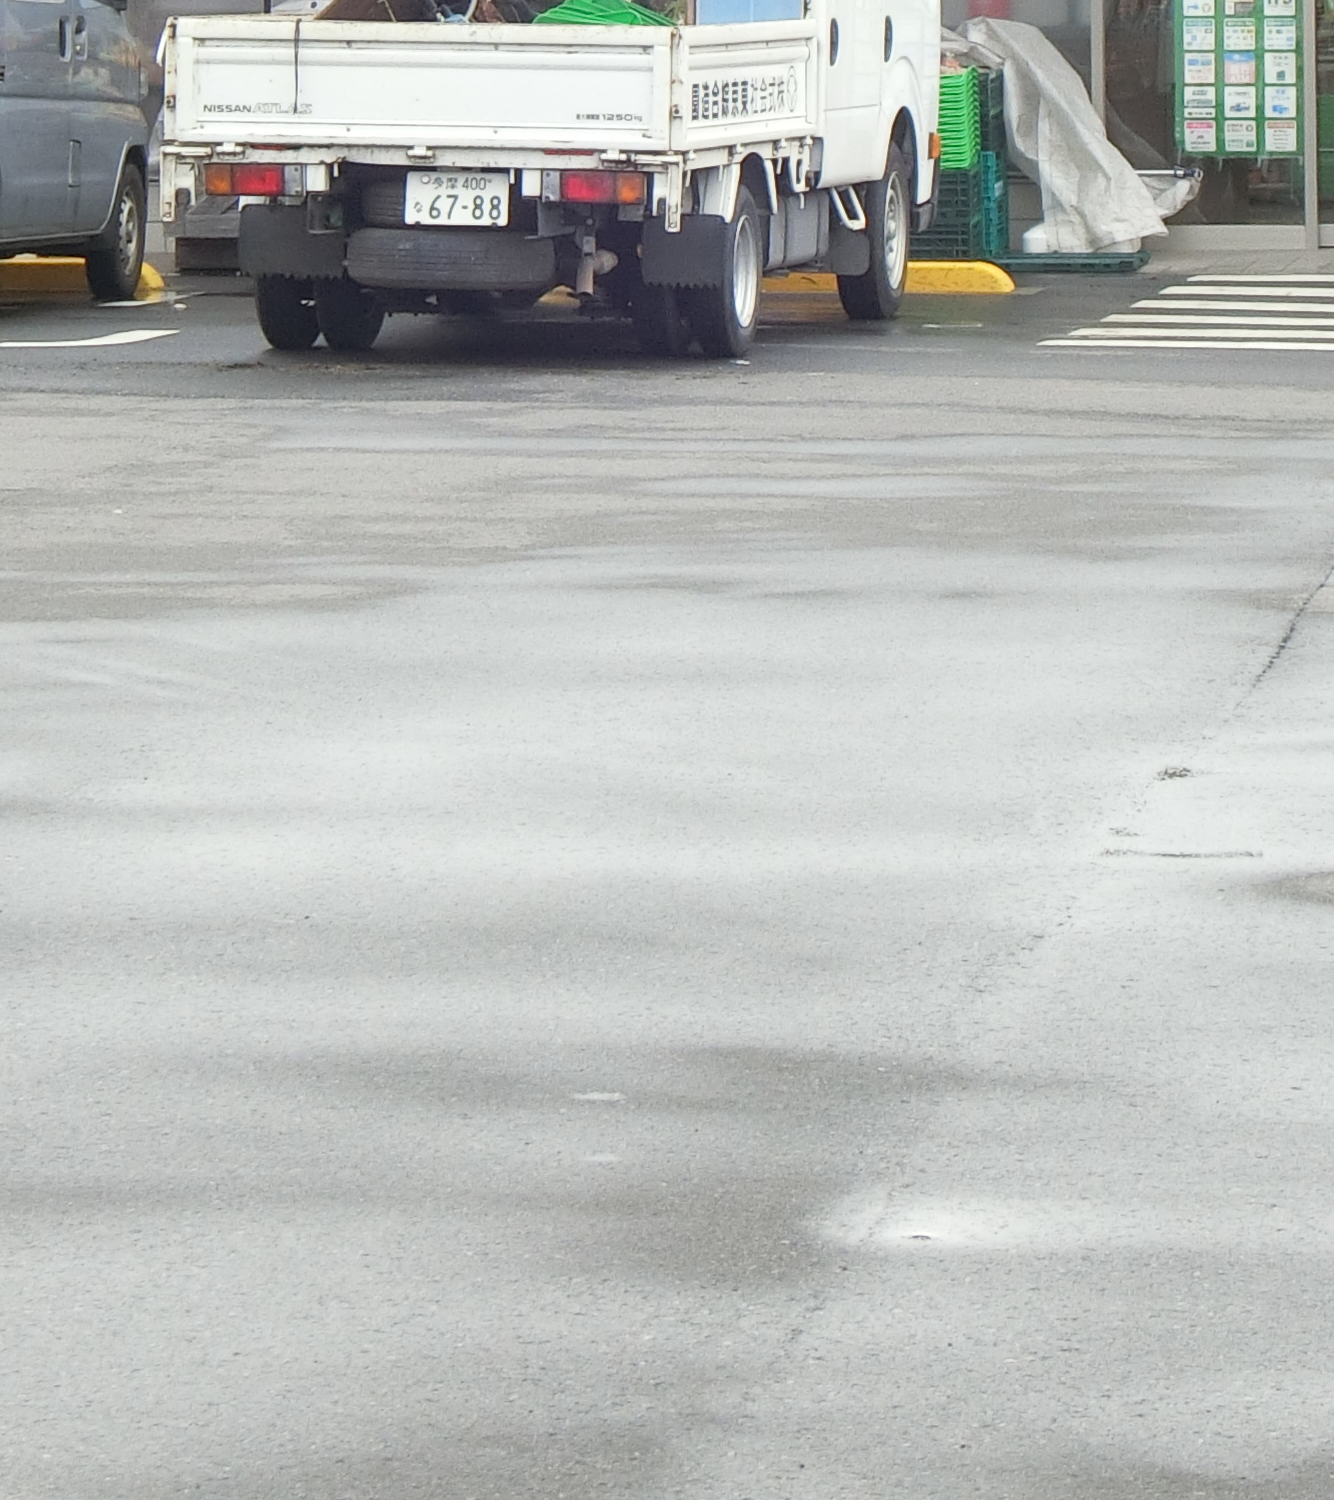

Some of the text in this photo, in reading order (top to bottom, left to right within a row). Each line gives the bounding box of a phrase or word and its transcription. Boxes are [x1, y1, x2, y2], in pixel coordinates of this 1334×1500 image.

[203, 102, 313, 114] NISSAN ATLAS
[462, 177, 487, 190] 400
[429, 194, 502, 220] 67-88
